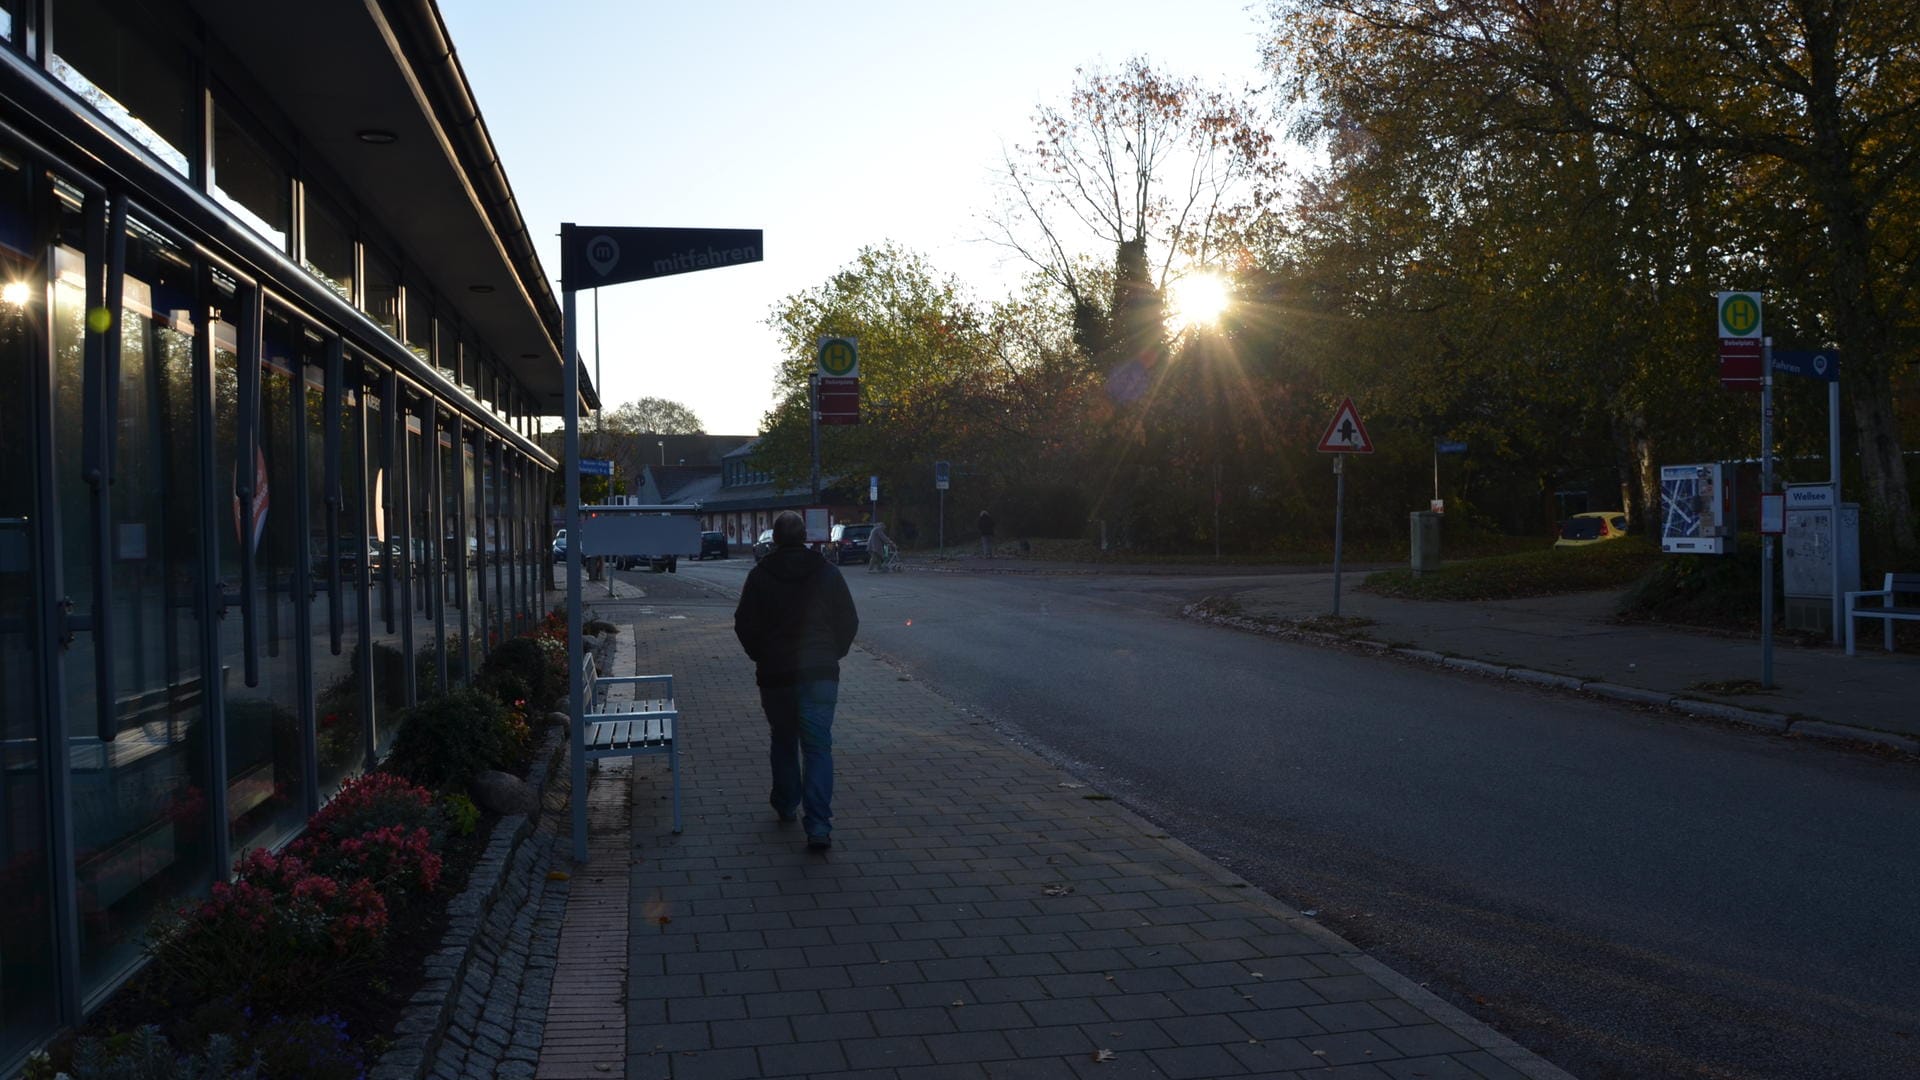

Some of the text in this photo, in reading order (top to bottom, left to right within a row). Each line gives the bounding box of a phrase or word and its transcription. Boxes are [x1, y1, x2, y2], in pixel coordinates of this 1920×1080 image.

[596, 246, 610, 258] m
[653, 245, 757, 273] mitfahren
[1732, 303, 1748, 326] H
[831, 347, 846, 368] H
[1772, 358, 1801, 373] fahren
[1793, 491, 1826, 501] Wellsee
